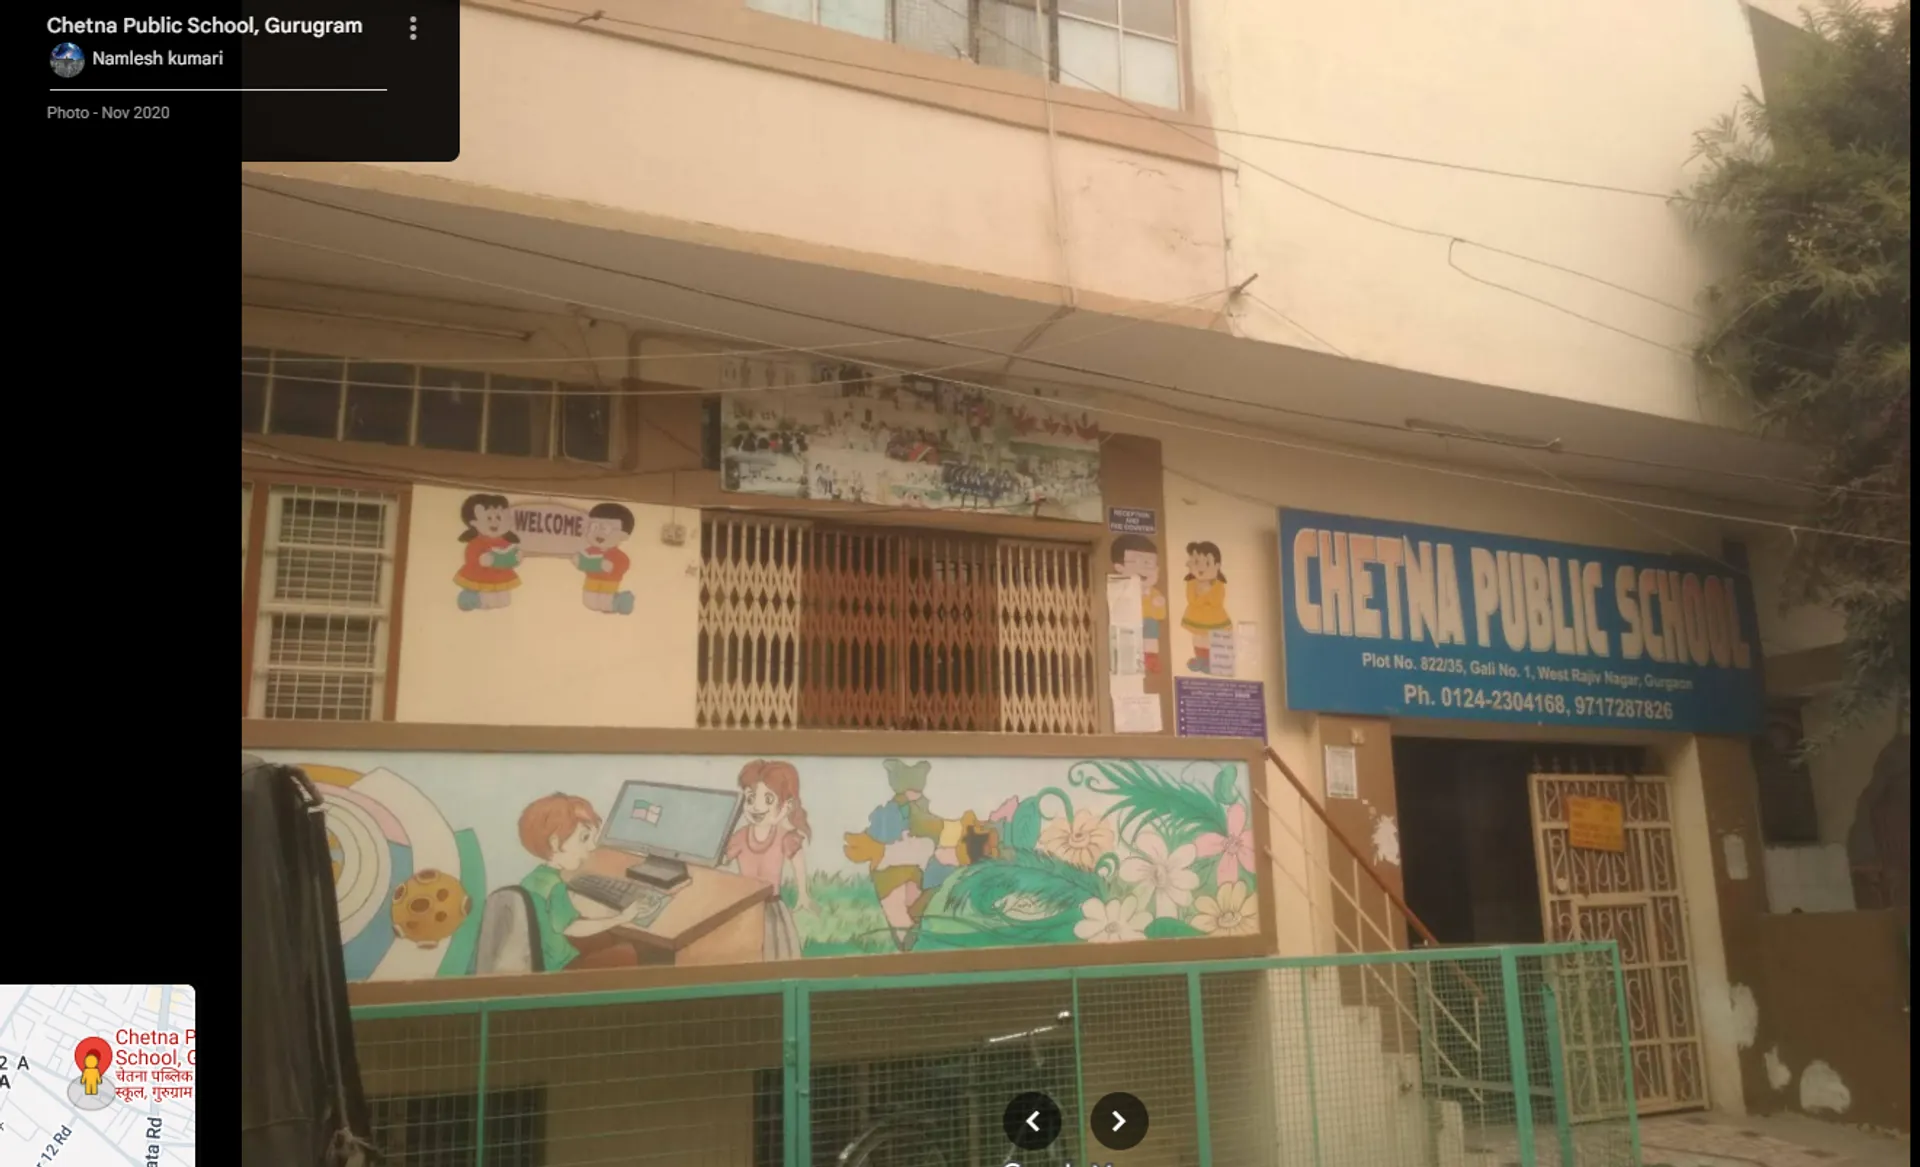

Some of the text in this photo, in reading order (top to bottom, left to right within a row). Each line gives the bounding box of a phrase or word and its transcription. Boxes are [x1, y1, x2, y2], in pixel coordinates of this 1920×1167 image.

[514, 509, 583, 537] WELCOME
[1293, 528, 1751, 669] CHETNA PUBLIC SCHOOL
[1362, 651, 1693, 692] Plot No. 822/35, Gali No. 1, West Rajiv Nagar, Gurgaon
[1403, 683, 1674, 721] Ph. 0124-2304168, 9717287826
